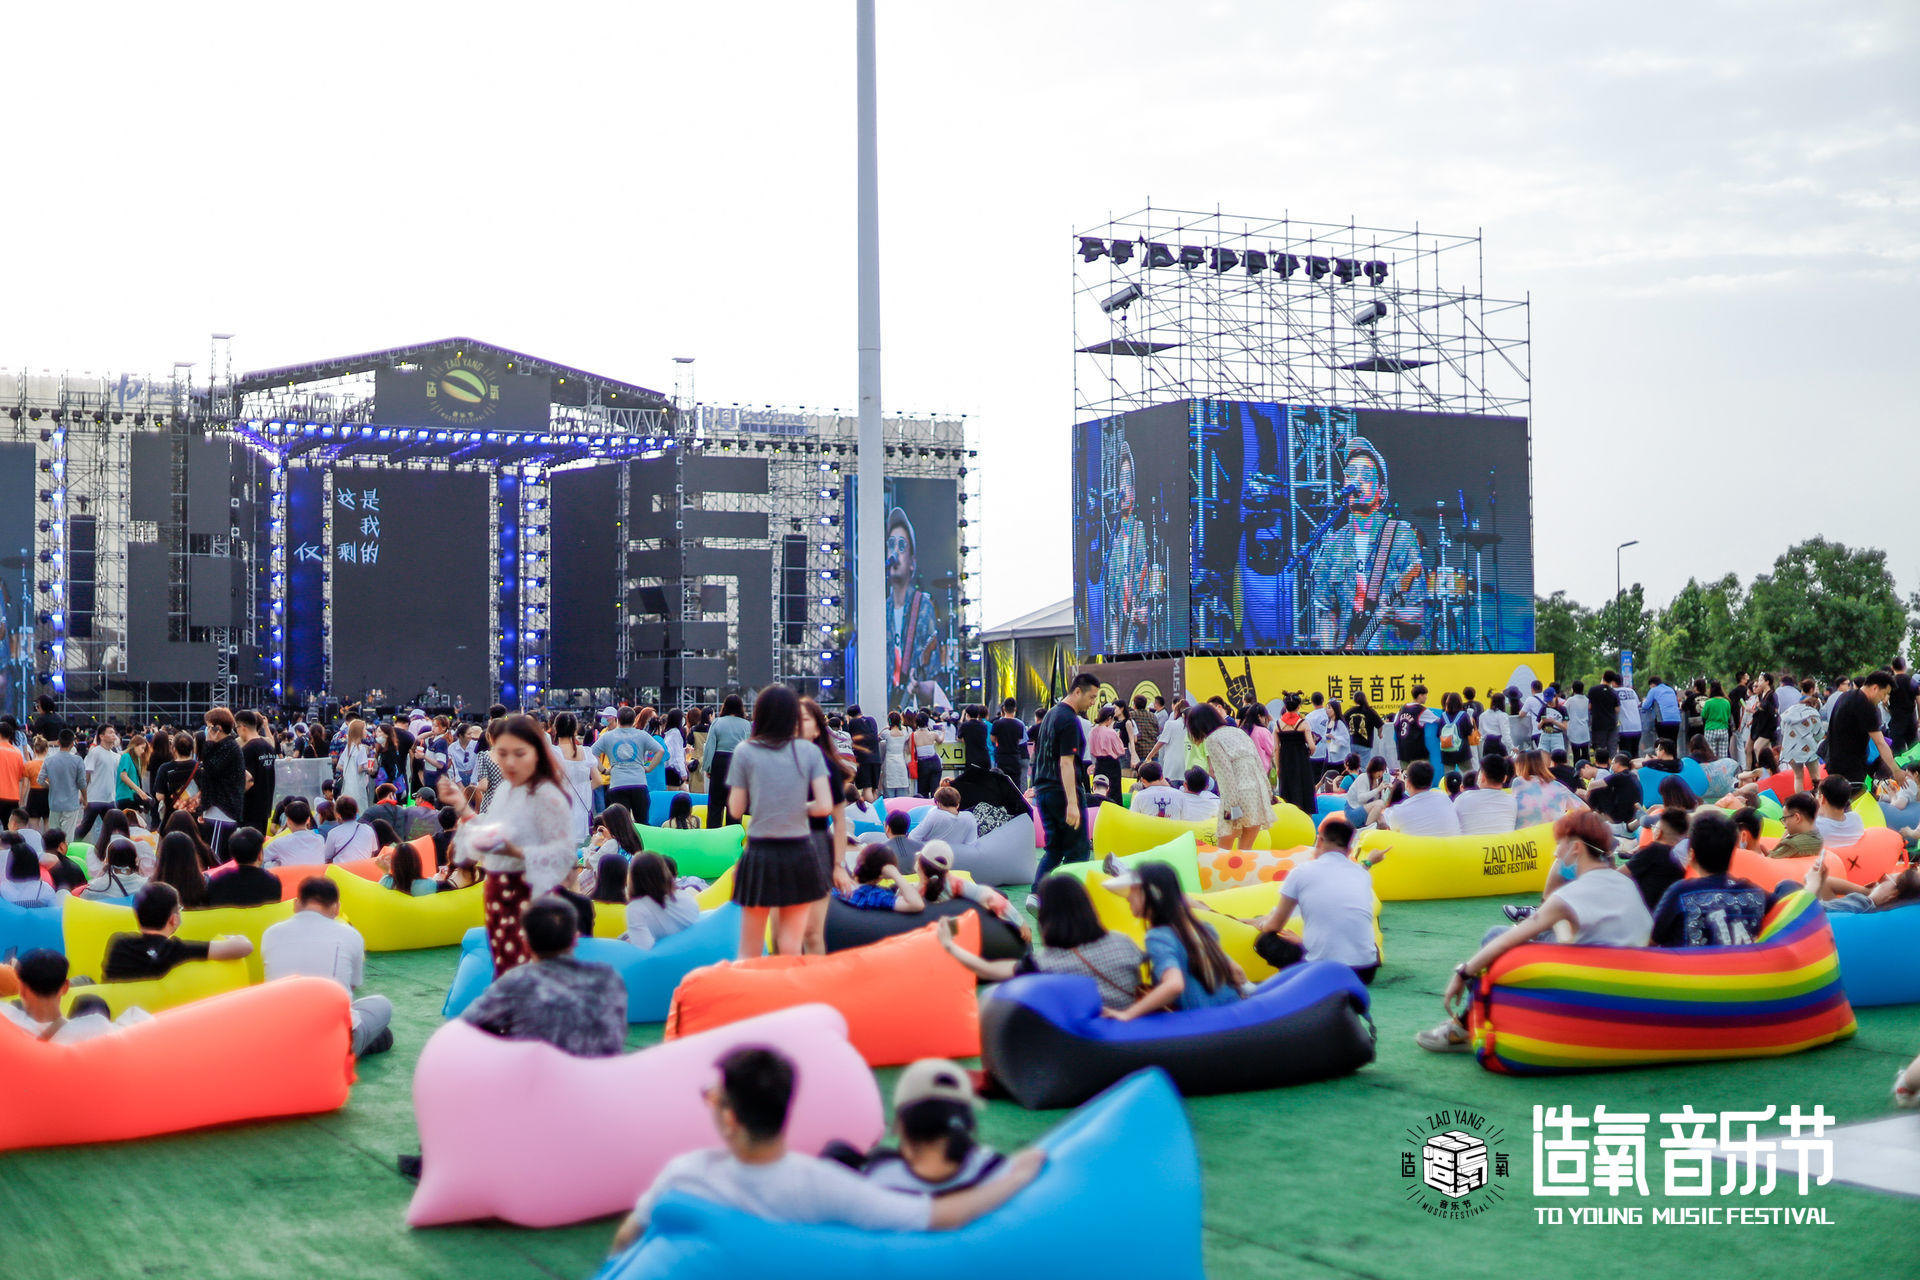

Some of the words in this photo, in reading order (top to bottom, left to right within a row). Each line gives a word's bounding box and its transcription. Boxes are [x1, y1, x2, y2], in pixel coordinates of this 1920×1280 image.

[337, 487, 380, 512] 这是
[360, 514, 380, 538] 我
[1173, 657, 1181, 697] MUSI
[1400, 721, 1408, 737] 3
[940, 748, 963, 760] 入口
[1482, 845, 1507, 865] ZAO
[1506, 840, 1538, 862] YANG
[1483, 864, 1506, 876] MUSIC
[1507, 860, 1538, 874] FESTIVAL
